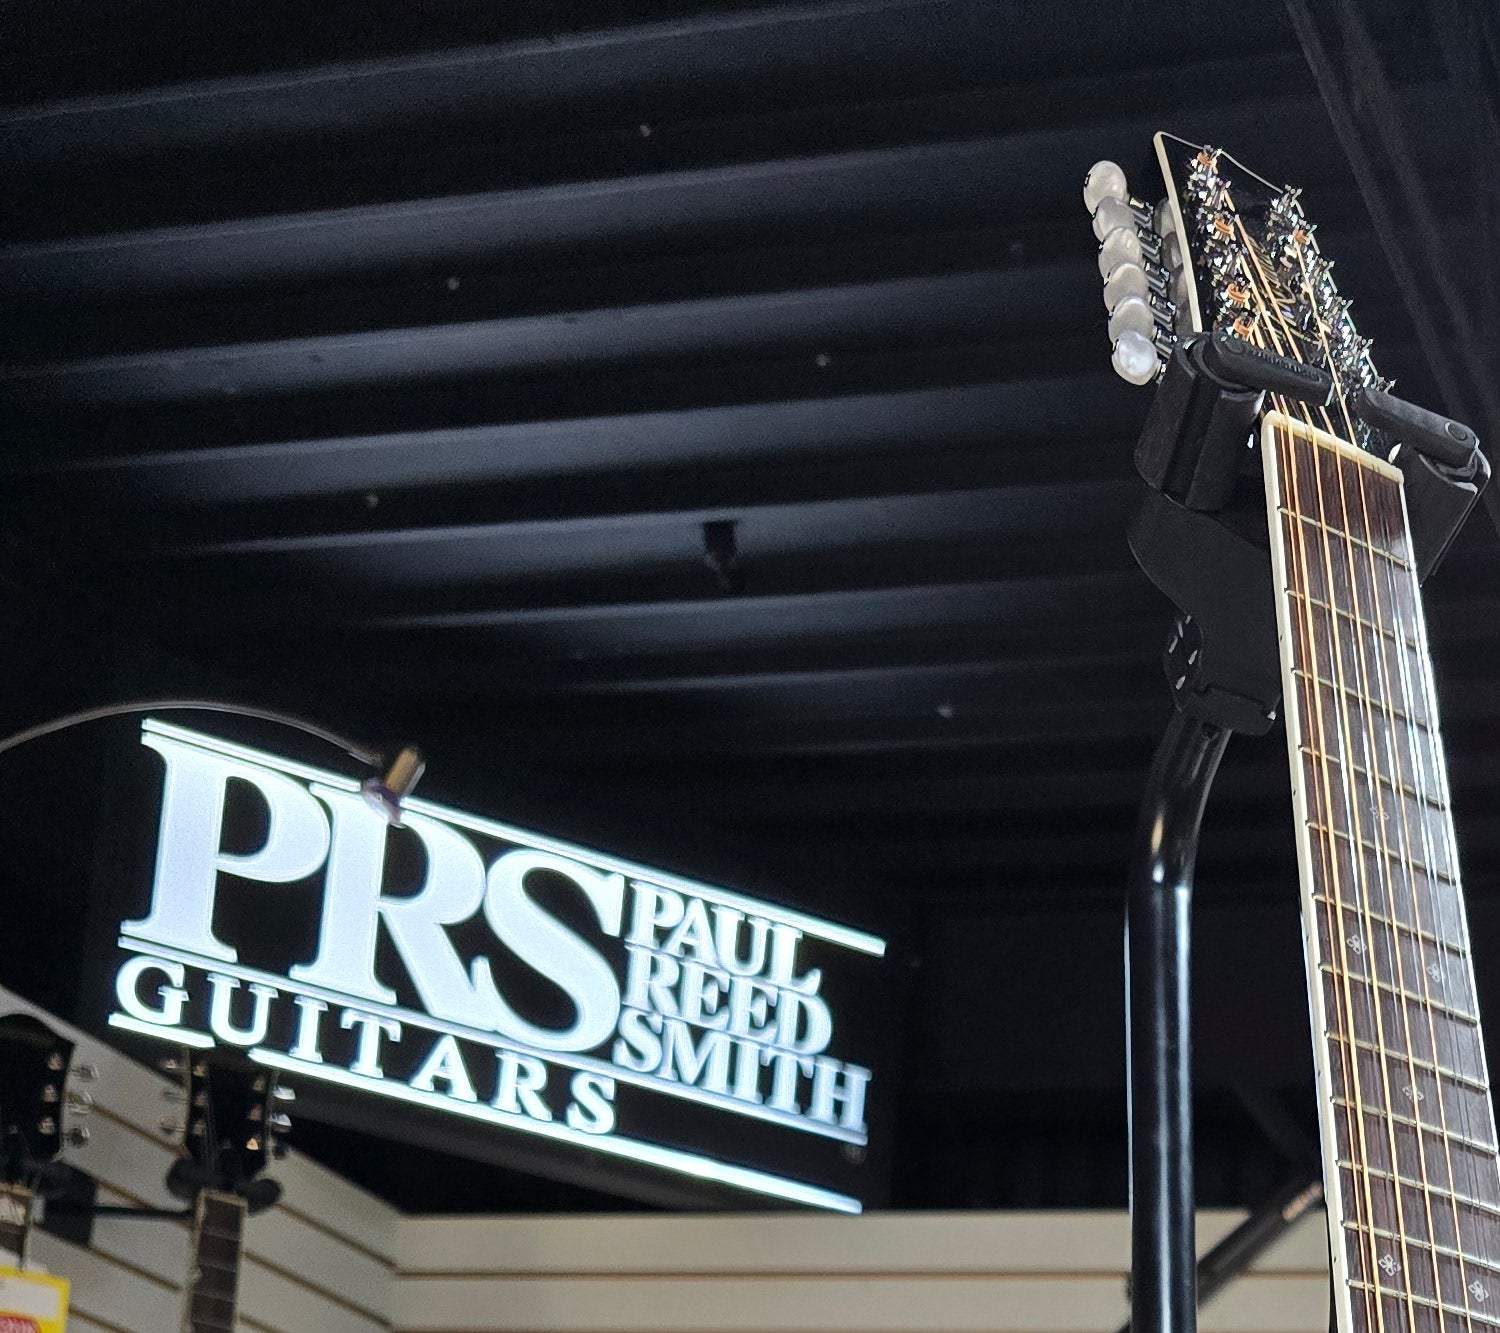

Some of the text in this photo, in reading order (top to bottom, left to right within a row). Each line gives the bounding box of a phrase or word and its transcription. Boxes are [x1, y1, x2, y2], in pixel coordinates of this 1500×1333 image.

[119, 733, 626, 1053] PRS
[626, 879, 821, 996] PAUL
[115, 955, 618, 1136] GUITARS
[624, 944, 833, 1056] REED
[613, 1011, 872, 1132] SMITH
